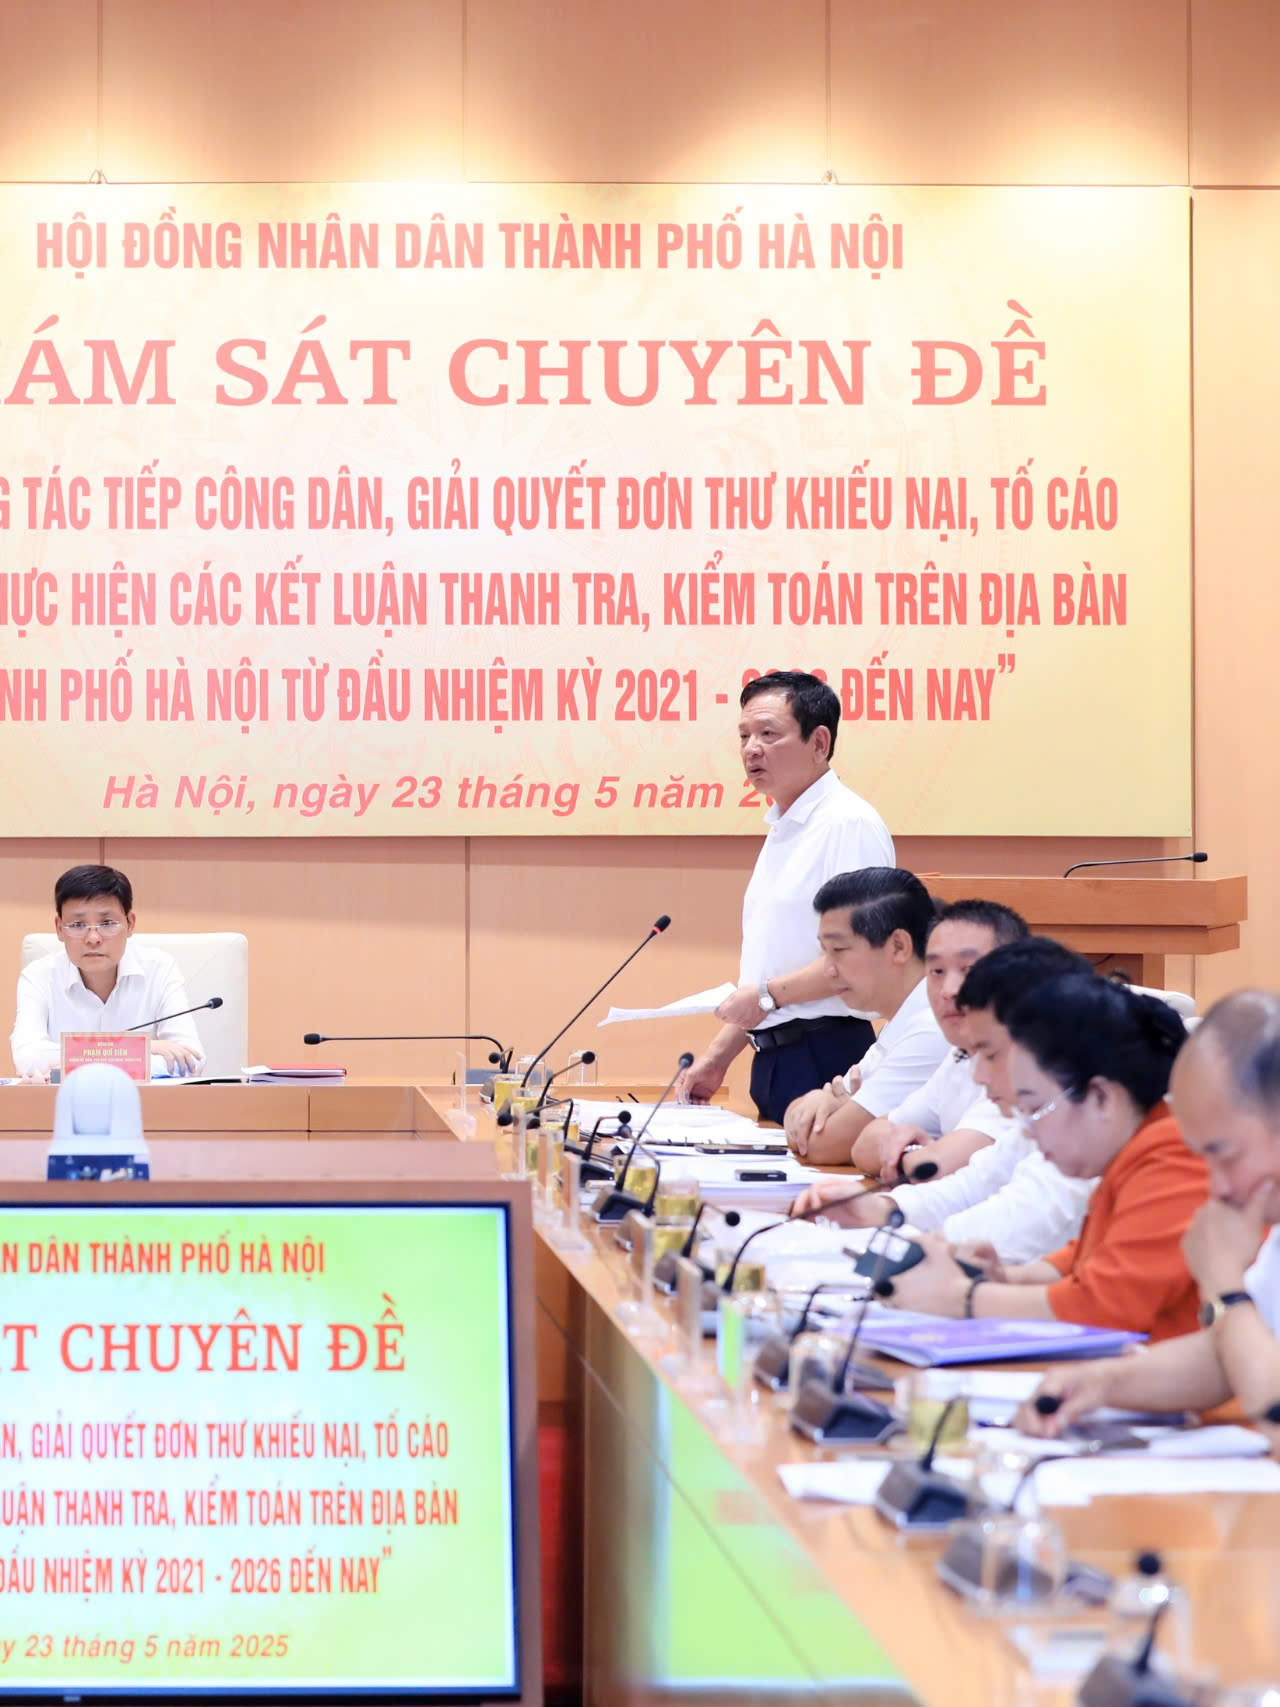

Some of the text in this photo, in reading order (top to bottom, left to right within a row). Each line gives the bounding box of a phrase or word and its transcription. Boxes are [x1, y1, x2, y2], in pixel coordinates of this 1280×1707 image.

[37, 206, 903, 279] HỘI ĐỒNG NHÂN DÂN THÀNH PHỐ HÀ NỘI
[216, 315, 410, 406] SÁT
[448, 319, 871, 406] CHUYÊN
[911, 299, 1047, 406] ĐỀ
[23, 466, 90, 530] TÁC
[104, 459, 181, 530] TIẾP
[196, 466, 294, 530] CÔNG
[308, 466, 394, 537] DÂN,
[407, 458, 479, 530] GIẢI
[493, 459, 605, 537] QUYẾT
[617, 472, 692, 530] ĐƠN
[705, 471, 776, 530] THƯ
[786, 459, 892, 530] KHIẾU
[905, 476, 978, 542] NẠI,
[991, 458, 1032, 530] TỐ
[1047, 466, 1118, 530] CÁO
[72, 562, 156, 638] HIỆN
[170, 562, 241, 626] CÁC
[256, 555, 321, 626] KẾT
[334, 562, 427, 638] LUẬN
[440, 572, 560, 626] THANH
[572, 572, 650, 632] TRA,
[663, 550, 755, 626] KIỂM
[767, 561, 863, 626] TOÁN
[875, 561, 967, 626] TRÊN
[979, 572, 1041, 638] ĐỊA
[1053, 561, 1127, 626] BÀN
[61, 649, 134, 721] PHỐ
[146, 658, 194, 721] HÀ
[207, 657, 269, 734] NỘI
[282, 658, 329, 721] TỪ
[337, 650, 411, 721] ĐẦU
[424, 657, 543, 734] NHIỆM
[557, 657, 603, 721] KỲ
[615, 668, 697, 722] 2021
[715, 693, 729, 704] -
[840, 651, 914, 721] ĐẾN
[926, 653, 1016, 721] NAY”
[103, 775, 159, 809] Hà
[175, 774, 255, 816] Nội,
[273, 774, 381, 817] ngày
[391, 775, 443, 809] 23
[457, 774, 580, 817] tháng
[594, 775, 621, 809] 5
[633, 774, 724, 809] năm
[28, 1235, 80, 1273] DÂN
[89, 1235, 171, 1273] THÀNH
[181, 1230, 230, 1273] PHỐ
[240, 1235, 272, 1273] HÀ
[282, 1235, 324, 1281] NỘI
[60, 1308, 302, 1372] CHUYÊN
[327, 1293, 405, 1371] ĐỀ
[31, 1410, 72, 1458] GIẢI
[81, 1410, 145, 1462] QUYẾT
[154, 1420, 197, 1458] ĐƠN
[206, 1420, 247, 1458] THƯ
[253, 1410, 315, 1458] KHIẾU
[323, 1423, 366, 1468] NẠI,
[373, 1408, 399, 1458] TỐ
[407, 1414, 448, 1458] CÁO
[54, 1490, 123, 1526] THANH
[131, 1490, 176, 1529] TRA,
[184, 1474, 238, 1526] KIỂM
[246, 1481, 302, 1526] TOÁN
[310, 1481, 363, 1526] TRÊN
[371, 1490, 407, 1534] ĐỊA
[414, 1481, 458, 1526] BÀN
[44, 1549, 113, 1602] NHIỆM
[121, 1549, 147, 1593] KỲ
[156, 1558, 204, 1594] 2021
[231, 1558, 281, 1594] 2026
[289, 1545, 332, 1593] ĐẾN
[25, 1634, 54, 1658] 23
[63, 1633, 135, 1665] tháng
[145, 1634, 158, 1658] 5
[167, 1636, 221, 1658] năm
[230, 1634, 289, 1658] 2025
